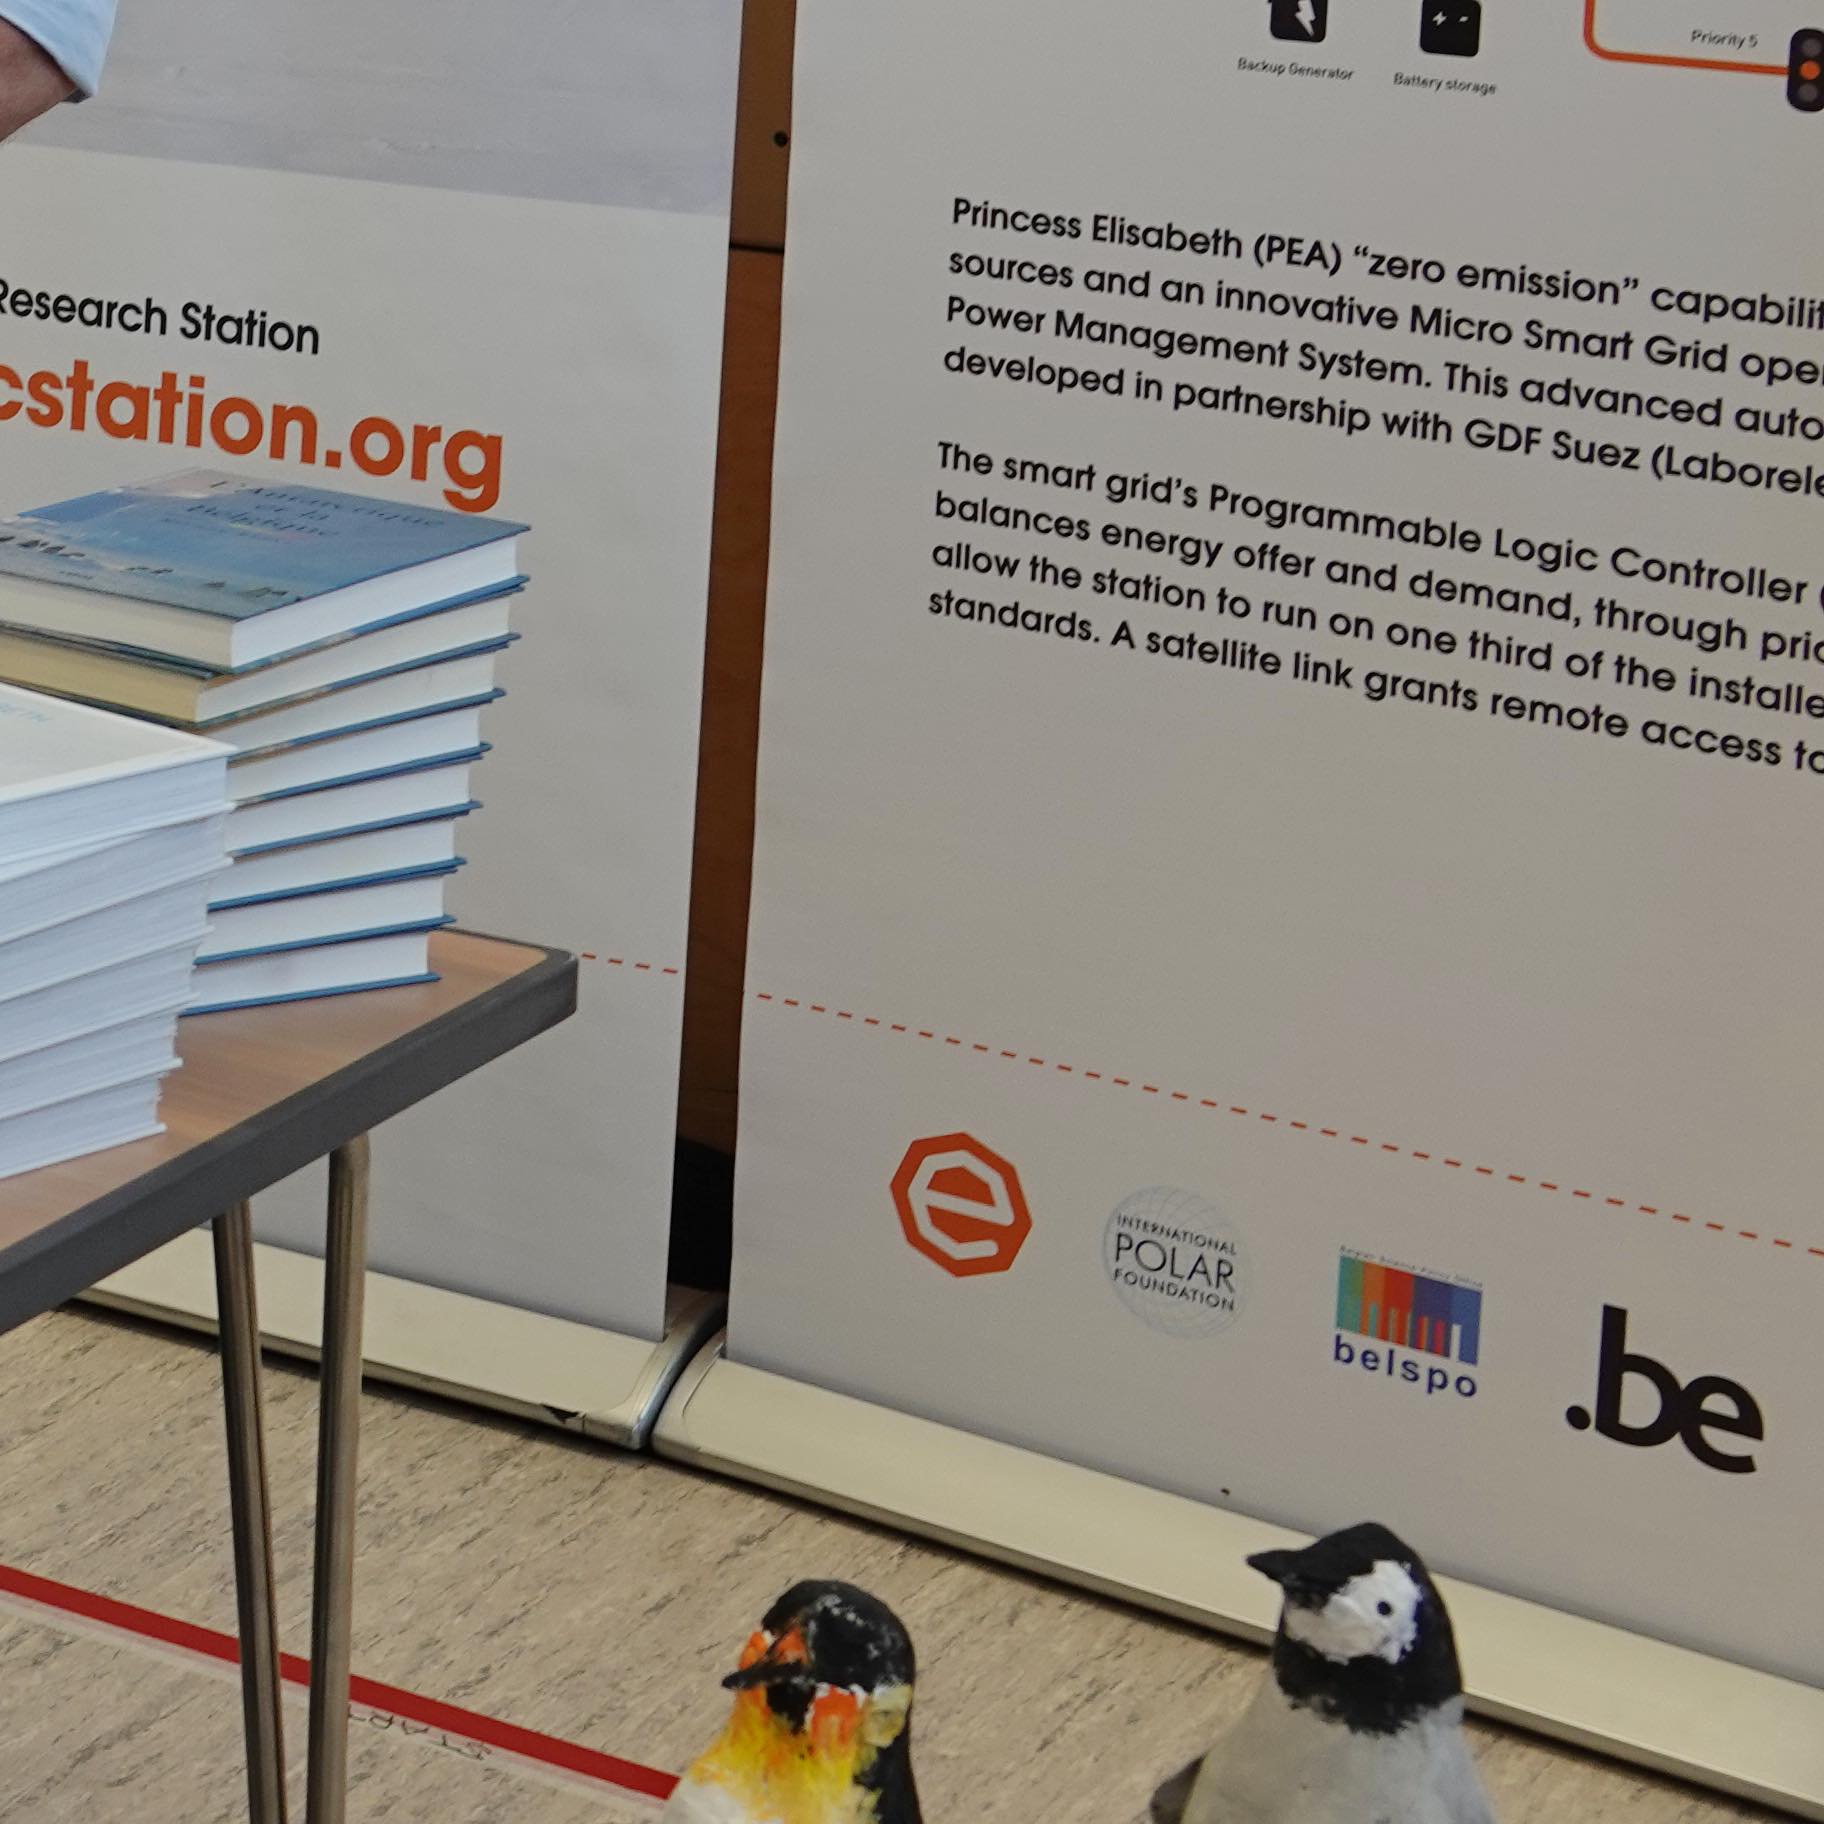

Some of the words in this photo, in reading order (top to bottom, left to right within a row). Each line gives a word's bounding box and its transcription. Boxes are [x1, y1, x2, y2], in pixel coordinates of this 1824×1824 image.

[1236, 56, 1287, 78] Backup
[1287, 61, 1356, 81] Generator
[1690, 29, 1747, 51] Priority
[1392, 71, 1444, 93] Battery
[1444, 78, 1498, 97] storage
[952, 196, 1082, 240] Princess
[1091, 213, 1243, 260] Elisabeth
[1253, 232, 1342, 278] (PEA)
[179, 301, 320, 356] Station
[948, 251, 1074, 289] sources
[1083, 269, 1152, 299] and
[1159, 279, 1205, 306] an
[1215, 279, 1400, 331] innovative
[1409, 303, 1514, 346] Micro
[1523, 318, 1635, 361] Smart
[1643, 334, 1729, 374] Grid
[1739, 352, 1824, 387] ope
[943, 345, 1125, 397] developed
[1134, 370, 1163, 403] in
[1172, 382, 1372, 437] partnership
[1380, 409, 1453, 444] with
[1463, 417, 1543, 456] GDF
[1551, 429, 1641, 471] Suez
[946, 294, 1047, 335] Power
[1054, 309, 1290, 368] Management
[1297, 341, 1432, 389] System.
[1443, 361, 1509, 399] This
[1519, 376, 1724, 428] advanced
[1734, 407, 1824, 442] auto
[937, 440, 994, 476] The
[1002, 456, 1097, 492] smart
[1209, 483, 1483, 554] Programmable
[1494, 527, 1599, 574] Logic
[1609, 546, 1809, 605] Controller
[935, 489, 1091, 542] balances
[1100, 523, 1225, 569] energy
[1233, 541, 1317, 579] offer
[1325, 559, 1398, 593] and
[1408, 569, 1581, 629] demand,
[1593, 596, 1748, 654] through
[931, 541, 1021, 579] allow
[1028, 554, 1083, 590] the
[1091, 567, 1206, 612] station
[1216, 586, 1252, 619] to
[1262, 600, 1318, 631] run
[1328, 612, 1375, 641] on
[1385, 622, 1458, 656] one
[1468, 629, 1554, 673] third
[1564, 650, 1605, 681] of
[1613, 653, 1677, 693] the
[927, 588, 1101, 644] standards.
[1109, 620, 1137, 650] A
[1145, 631, 1282, 676] satellite
[1292, 650, 1354, 690] link
[1363, 670, 1479, 712] grants
[1490, 693, 1630, 738] remote
[1640, 719, 1782, 767] access
[1115, 1232, 1235, 1294] POLAR
[1116, 1213, 1237, 1256] INTERNATIONAL
[1113, 1267, 1235, 1312] FOUNDATION
[1333, 1333, 1478, 1398] belspo
[1565, 1302, 1765, 1474] .be
